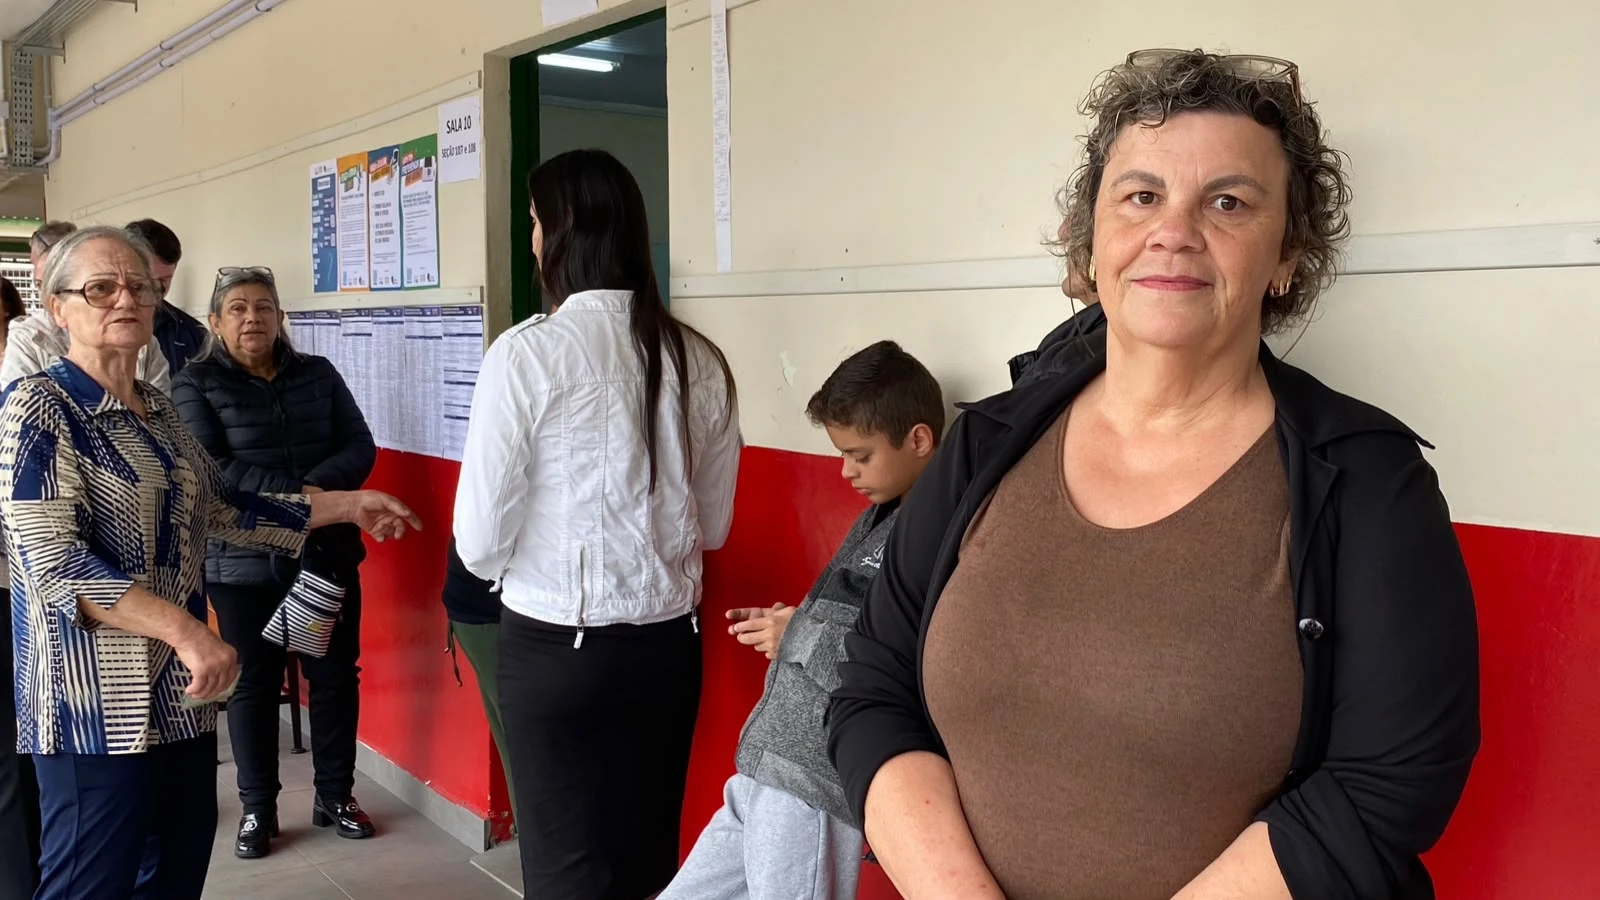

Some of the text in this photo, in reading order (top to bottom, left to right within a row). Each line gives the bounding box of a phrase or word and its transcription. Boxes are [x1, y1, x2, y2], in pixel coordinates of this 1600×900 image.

[446, 115, 472, 134] SALA 10
[442, 145, 455, 159] SEÇÃO
[455, 145, 463, 156] 107
